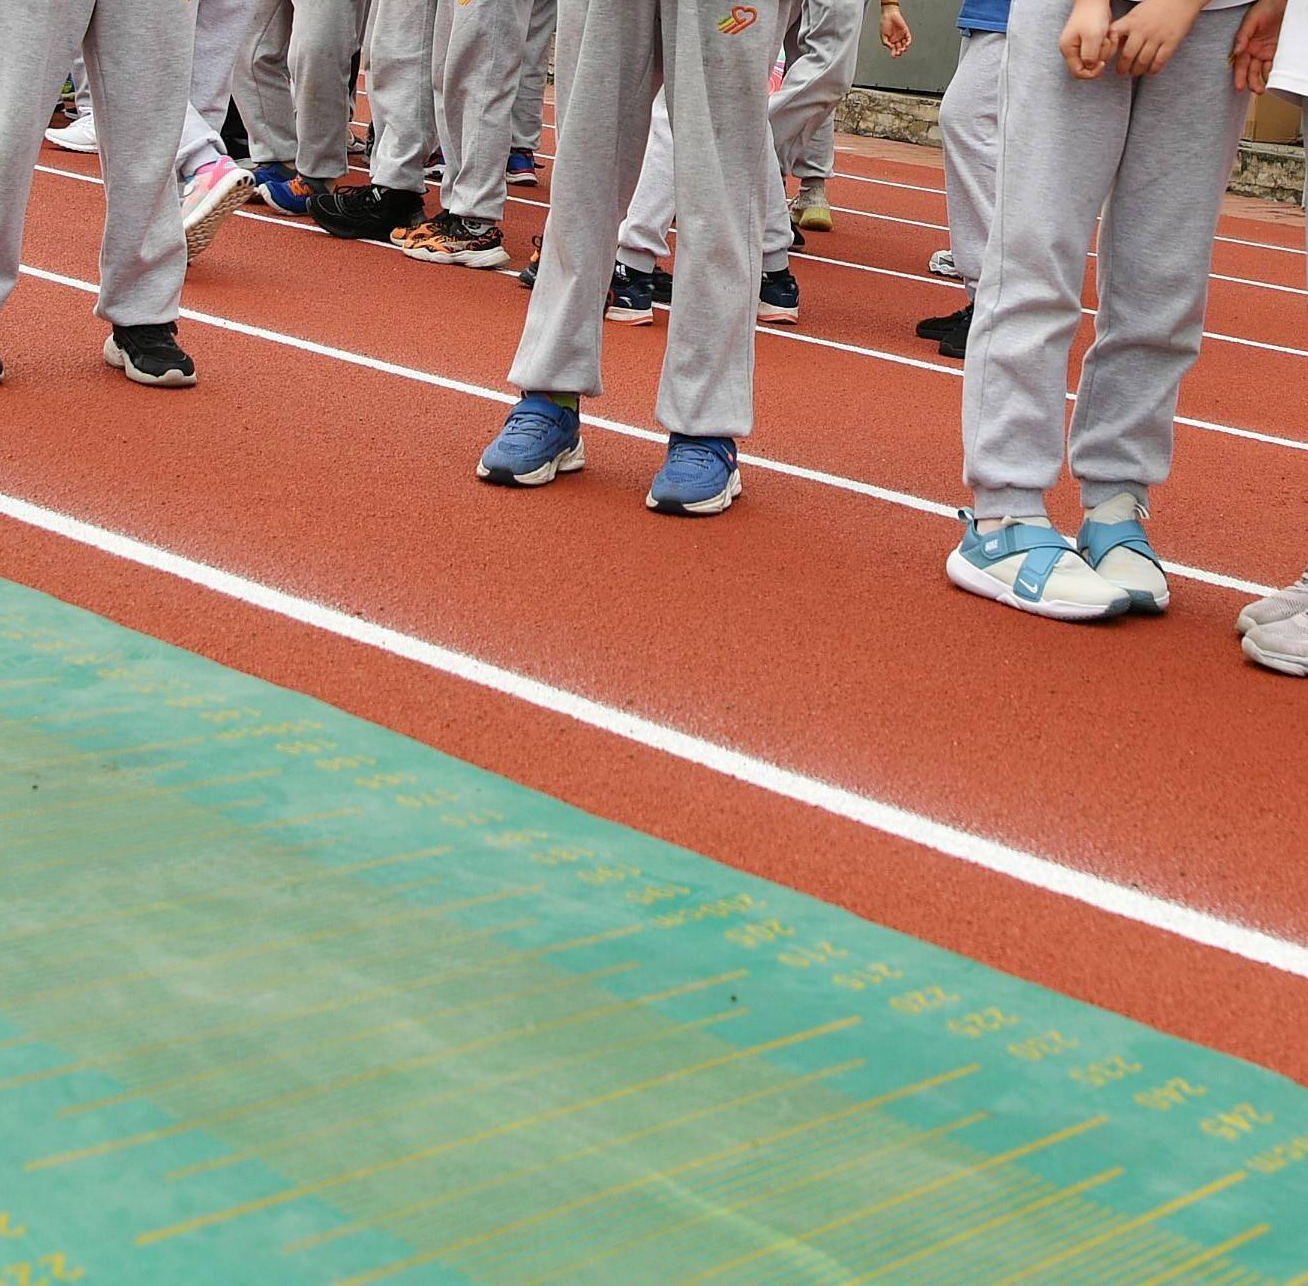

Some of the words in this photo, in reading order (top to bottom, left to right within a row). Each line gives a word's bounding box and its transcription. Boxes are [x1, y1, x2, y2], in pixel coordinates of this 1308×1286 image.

[723, 917, 797, 949] 205
[776, 939, 850, 968] 210
[831, 961, 906, 990] 215
[887, 985, 961, 1016] 220
[946, 1006, 1021, 1039] 225
[1133, 1076, 1209, 1111] 240
[1197, 1101, 1274, 1141] 245
